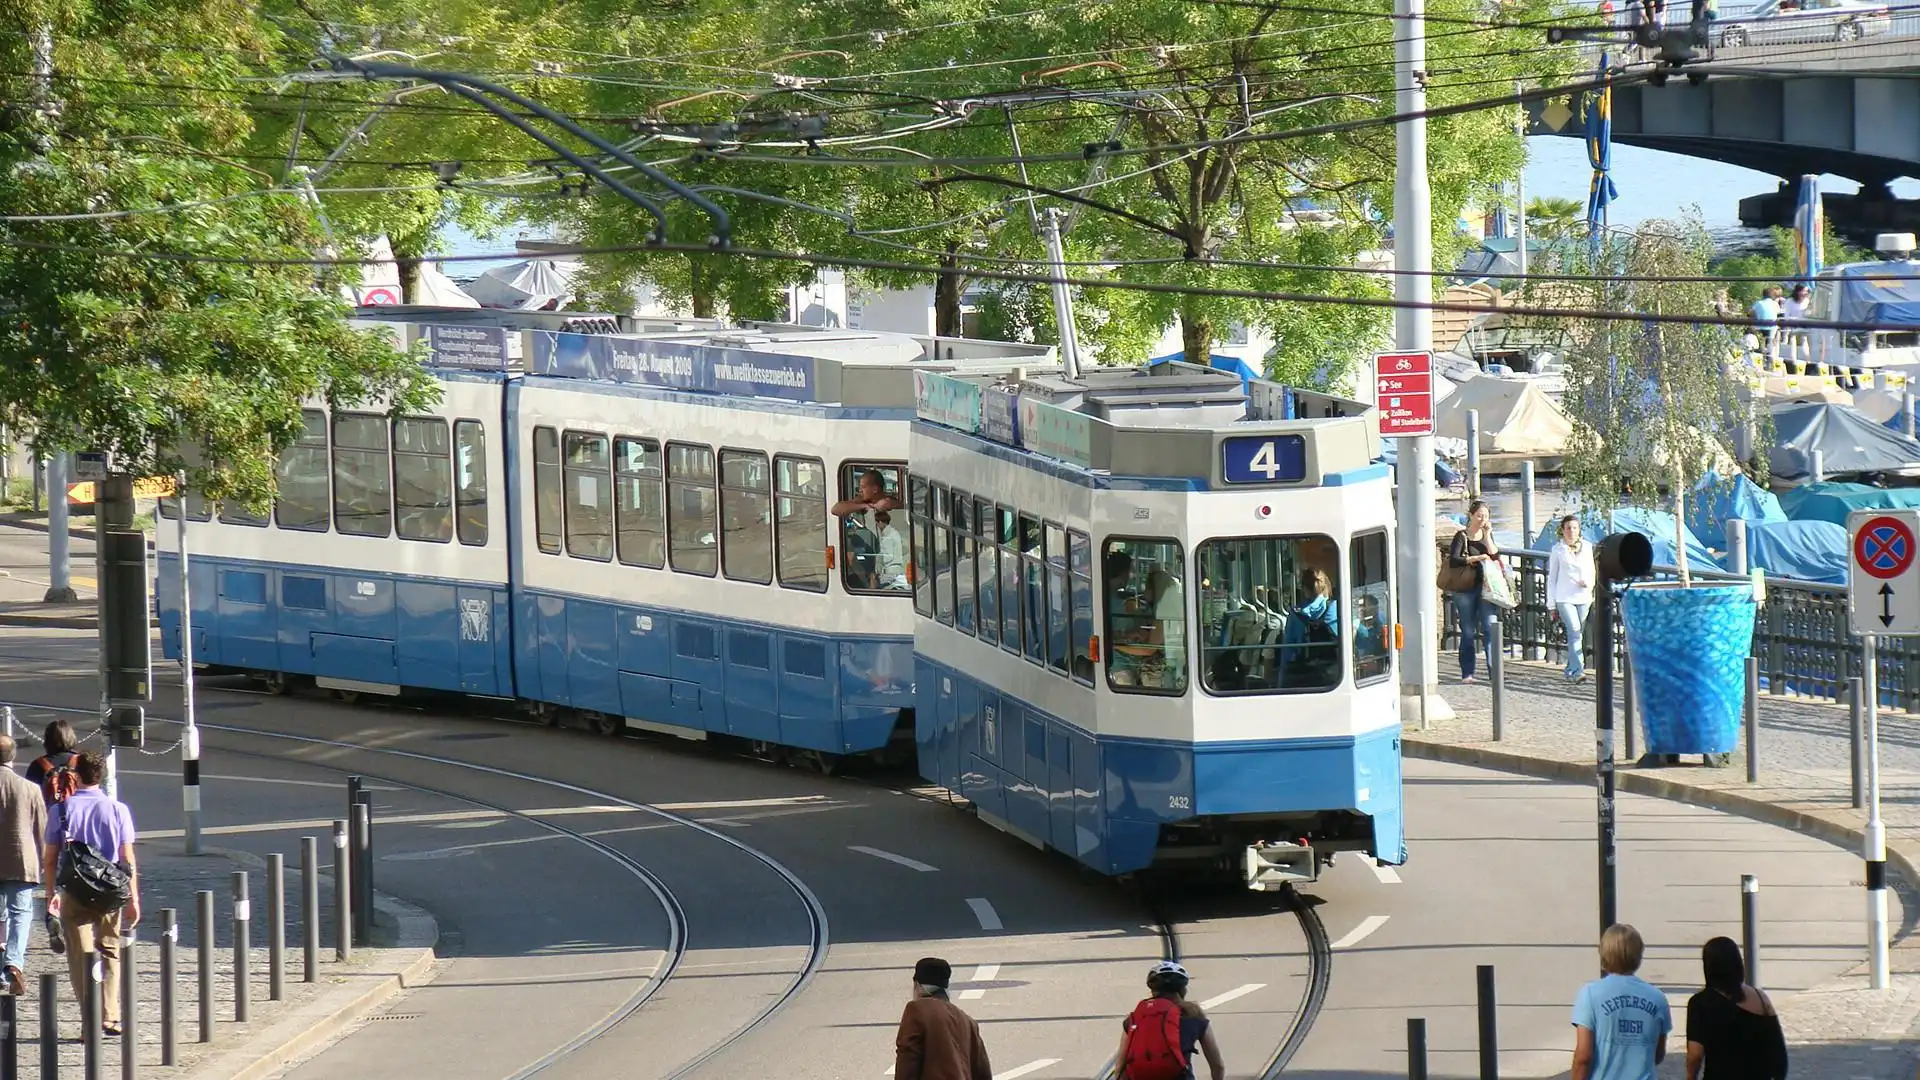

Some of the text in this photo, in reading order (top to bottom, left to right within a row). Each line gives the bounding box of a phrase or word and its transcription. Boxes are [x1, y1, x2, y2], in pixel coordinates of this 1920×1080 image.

[650, 353, 674, 377] August
[674, 356, 692, 376] 2009
[714, 362, 806, 388] www.weltklassezuerich.ch
[1389, 380, 1402, 389] See
[1249, 441, 1280, 479] 4
[1169, 795, 1189, 809] 2432
[1600, 995, 1659, 1016] JEFFERSON
[1619, 1019, 1643, 1034] HIGH
